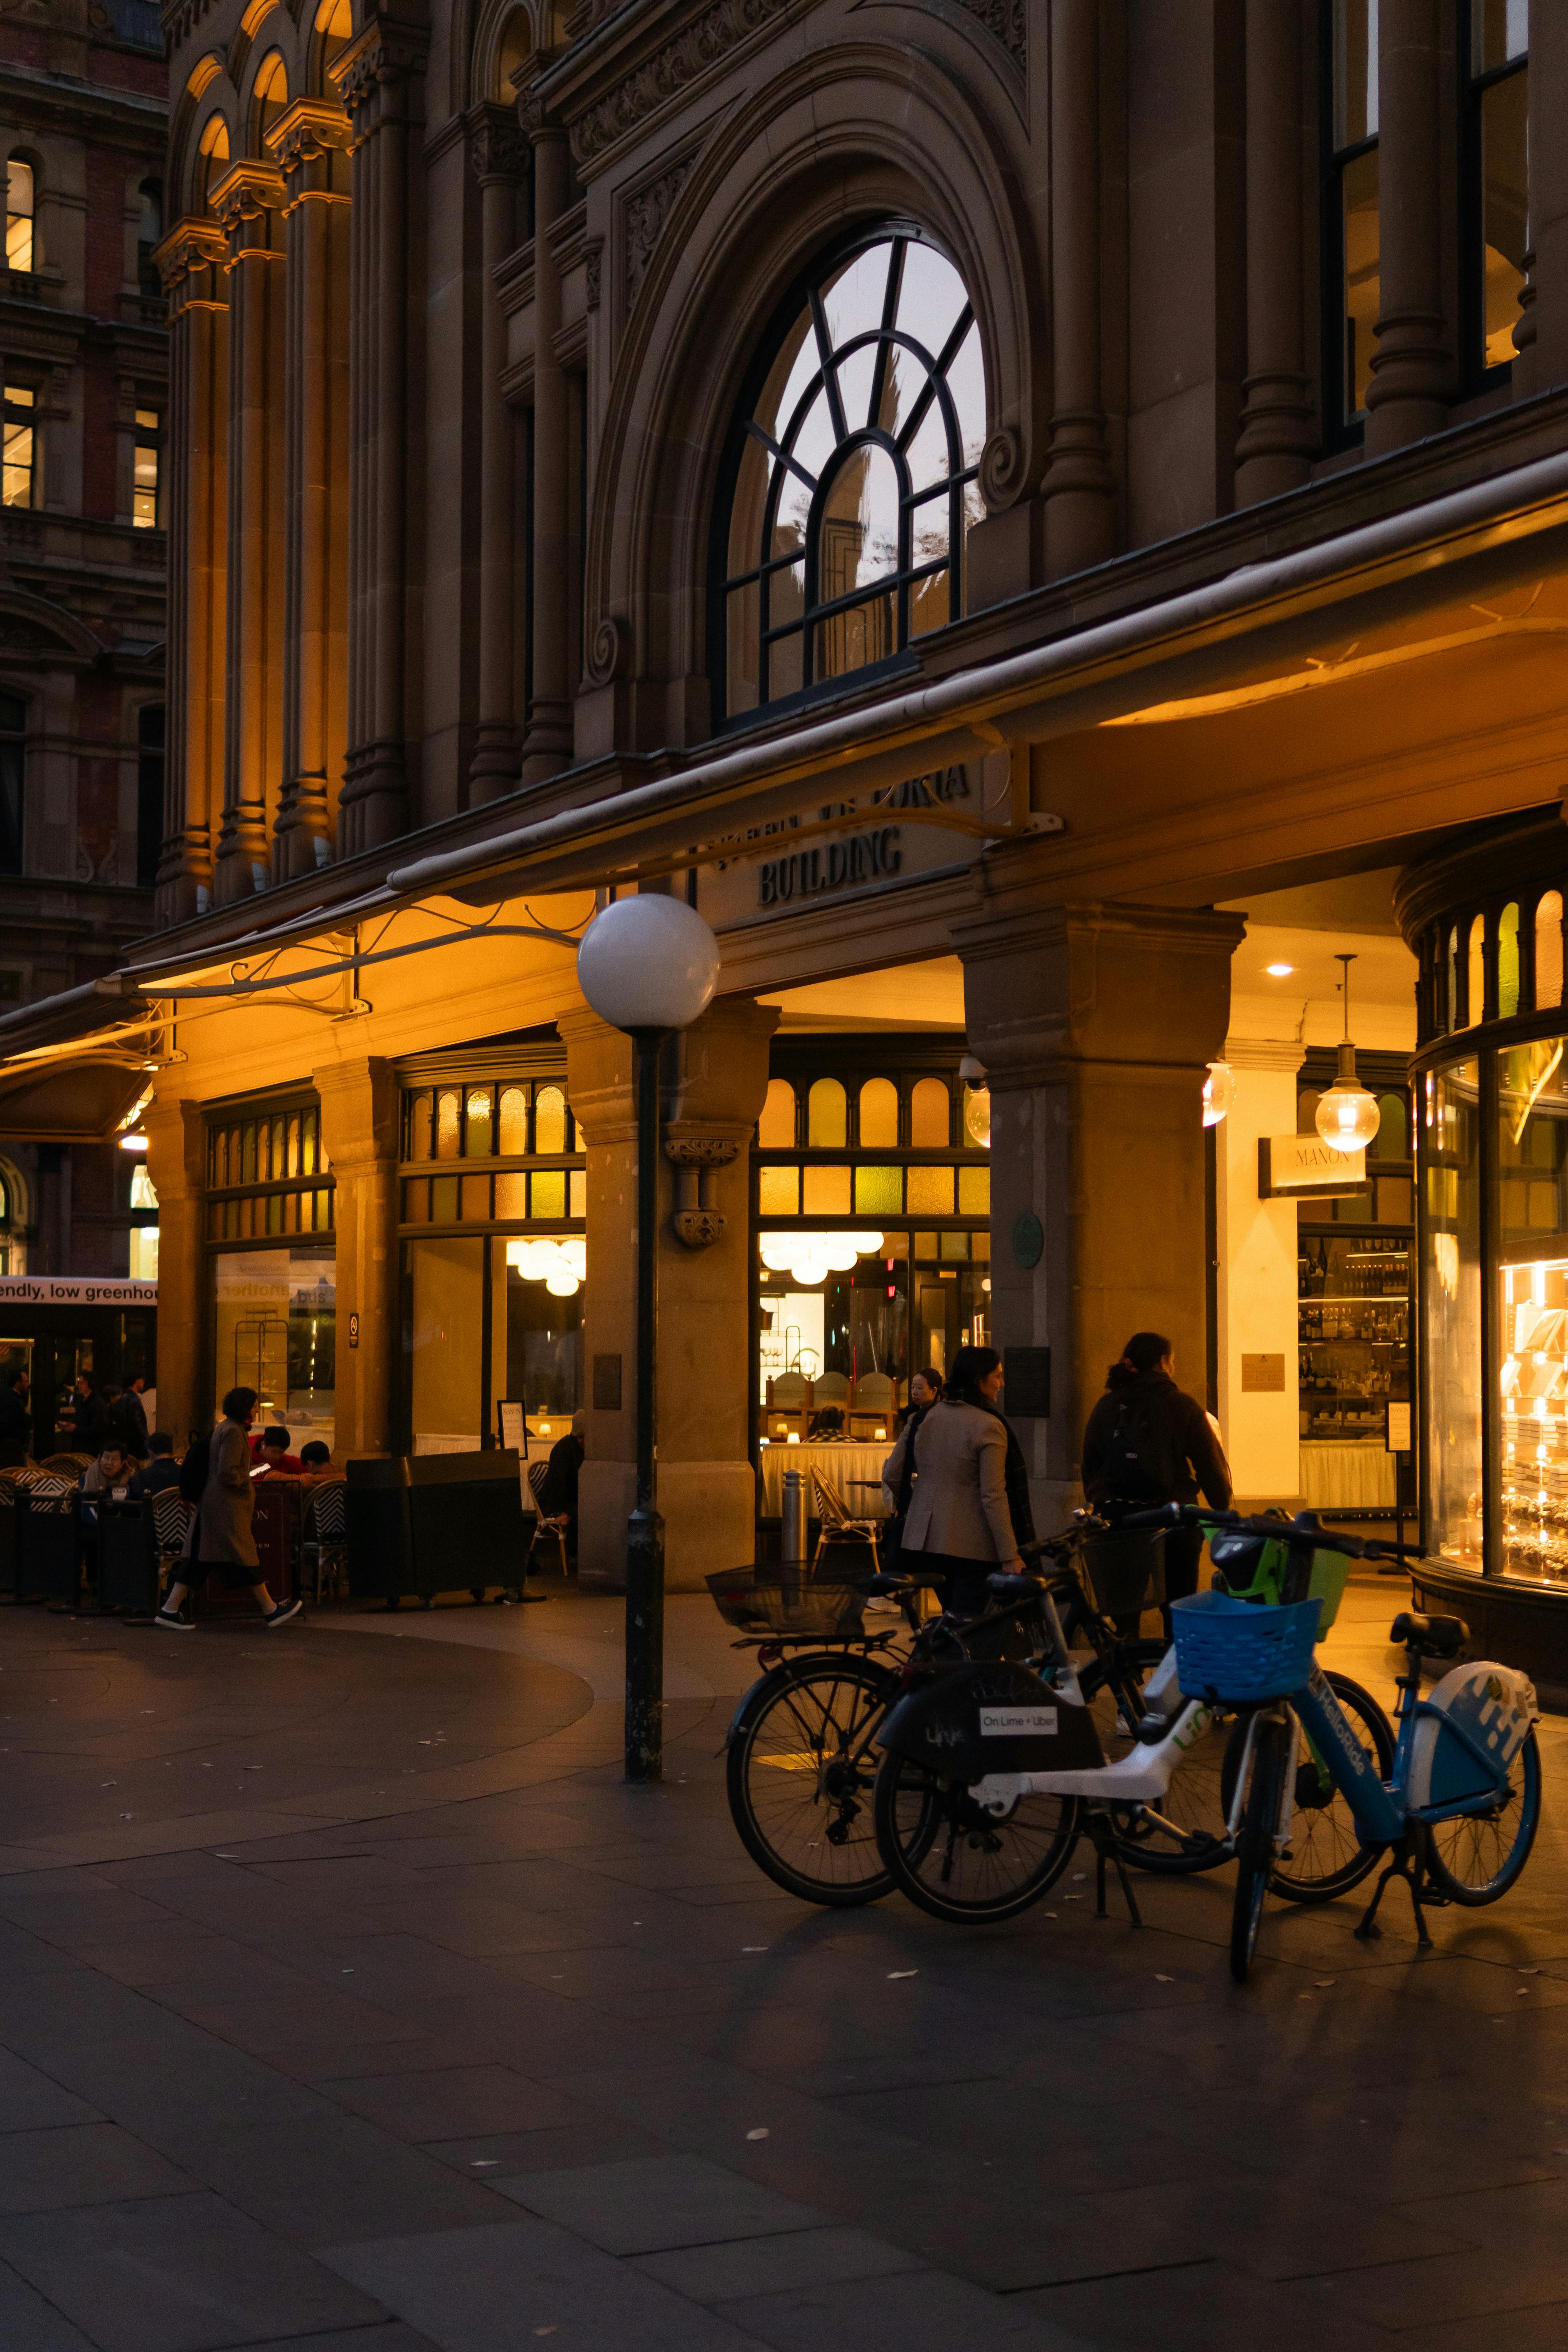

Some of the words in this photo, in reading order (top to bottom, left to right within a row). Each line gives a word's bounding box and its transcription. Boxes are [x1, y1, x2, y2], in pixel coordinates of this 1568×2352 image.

[757, 826, 902, 906] BUILDING
[1296, 1147, 1349, 1167] MANON
[51, 1284, 79, 1298] low
[85, 1286, 158, 1301] greenho
[984, 1716, 999, 1726] On
[1002, 1716, 1024, 1726] Lime
[1033, 1715, 1055, 1726] Uber
